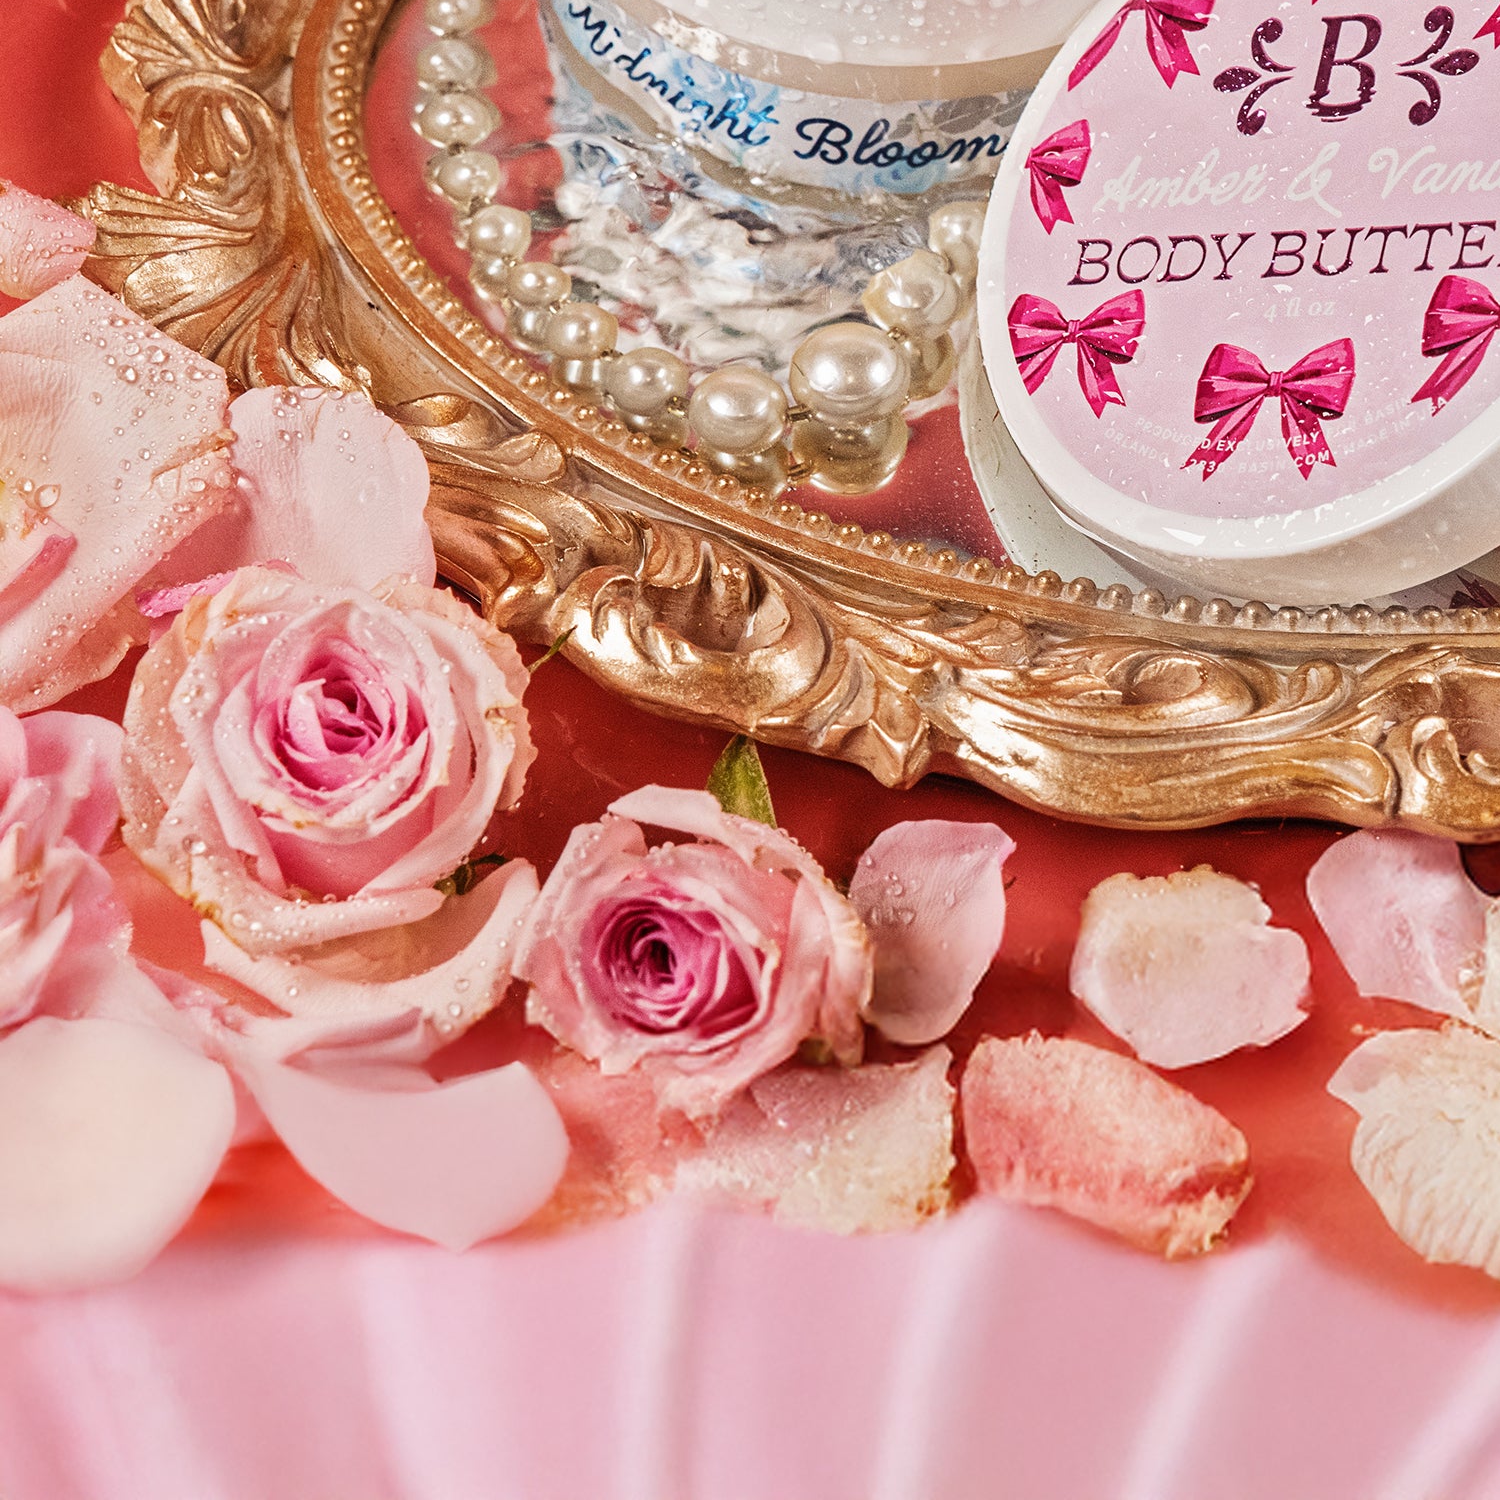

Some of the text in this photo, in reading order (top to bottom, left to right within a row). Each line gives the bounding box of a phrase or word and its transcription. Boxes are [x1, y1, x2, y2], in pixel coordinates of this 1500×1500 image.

[1305, 12, 1383, 123] B
[792, 117, 1009, 169] Bloom
[1092, 150, 1266, 216] Amber
[1287, 141, 1343, 219] &
[1067, 231, 1255, 287] BODY
